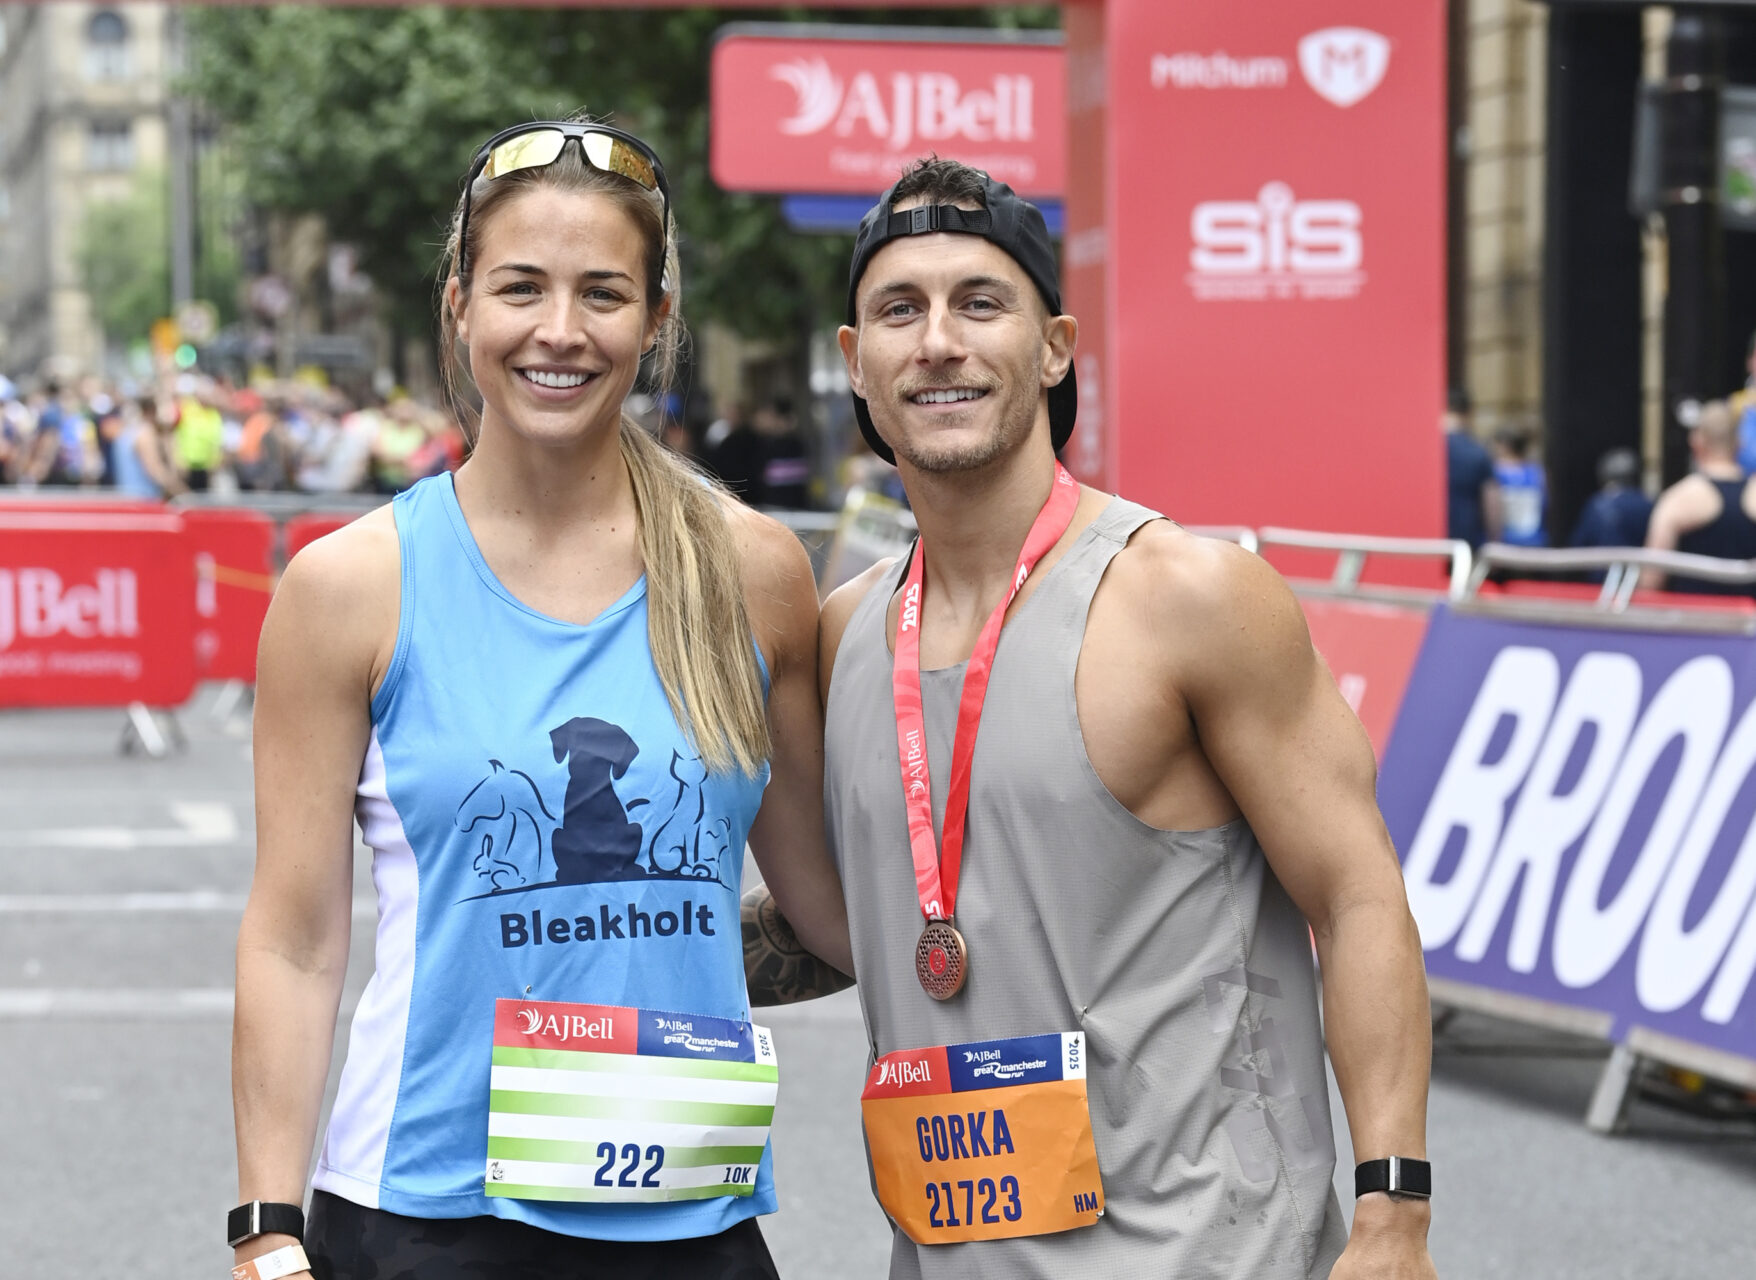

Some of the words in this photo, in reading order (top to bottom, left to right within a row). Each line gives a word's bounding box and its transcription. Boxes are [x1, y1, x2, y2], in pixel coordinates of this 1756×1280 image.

[832, 72, 1035, 147] AJBell
[902, 583, 920, 632] 2025
[907, 729, 925, 779] AJBell
[1402, 645, 1756, 1025] BROO
[500, 901, 716, 948] Bleakholt
[542, 1015, 614, 1041] AJBell
[691, 1038, 739, 1049] manchester
[759, 1034, 771, 1057] 2025
[887, 1060, 932, 1088] AJBell
[1001, 1060, 1047, 1073] manchester
[1069, 1043, 1079, 1070] 2025
[916, 1109, 1015, 1162] GORKA
[594, 1142, 665, 1188] 222
[723, 1167, 752, 1184] 10K
[926, 1175, 1022, 1228] 21723
[1074, 1192, 1098, 1213] HM
